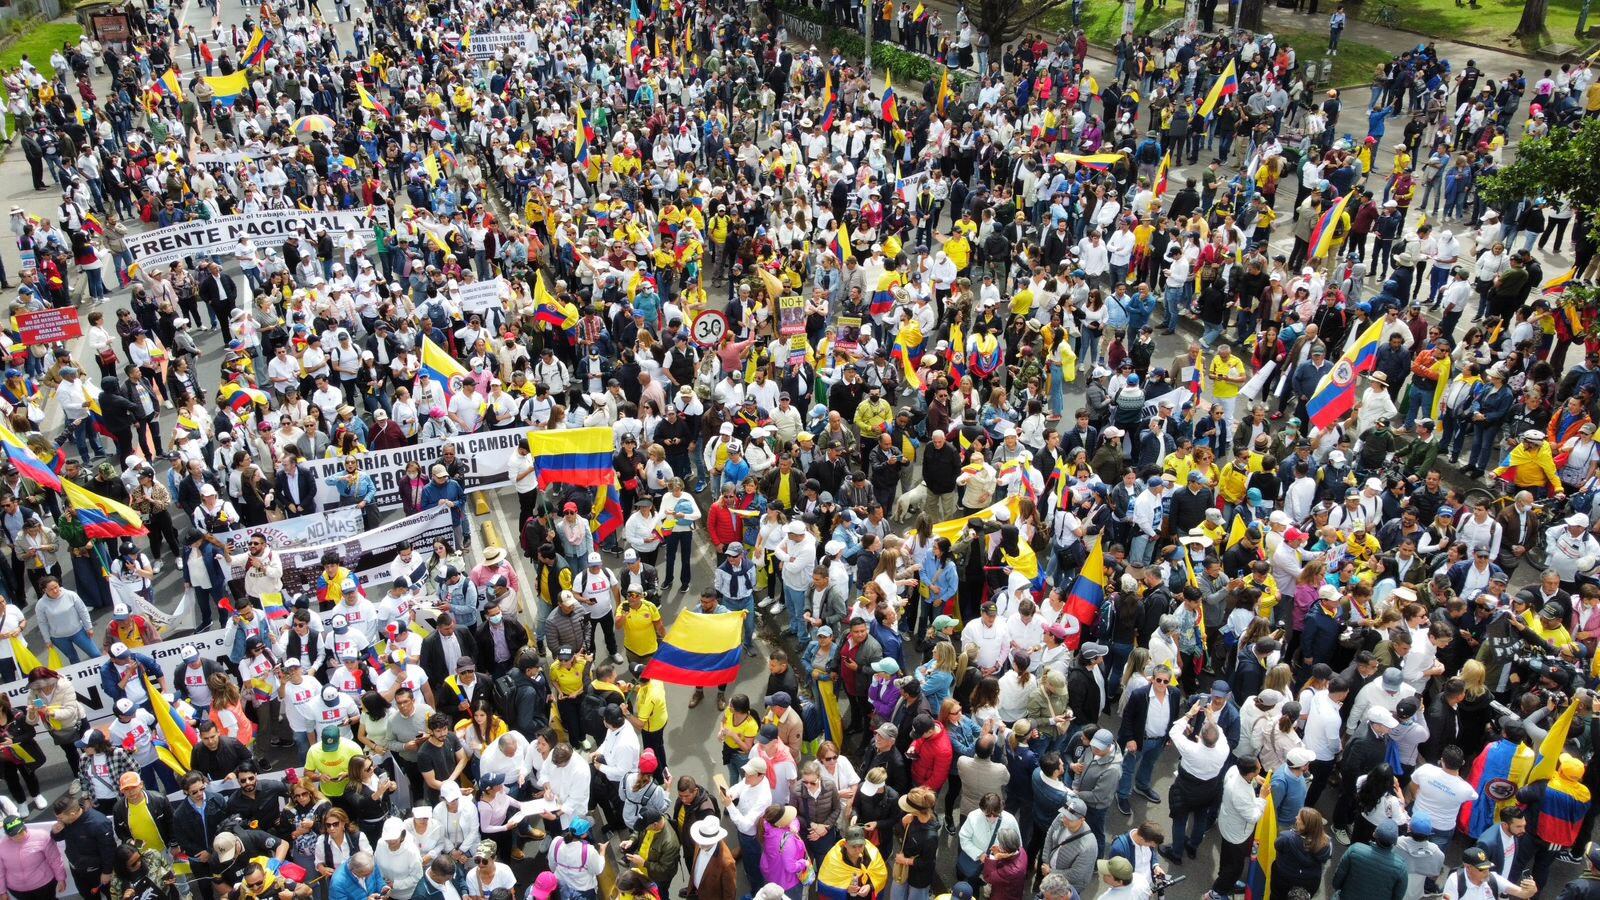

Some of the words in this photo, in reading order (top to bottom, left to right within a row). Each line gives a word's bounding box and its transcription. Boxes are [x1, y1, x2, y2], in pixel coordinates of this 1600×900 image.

[130, 227, 222, 260] FRENTE
[228, 216, 345, 240] NACIONAL
[782, 299, 794, 308] NO
[698, 318, 722, 338] 30
[323, 454, 392, 477] MAORÍA
[392, 444, 442, 466] QUIERE
[468, 434, 522, 453] CAMBIO
[308, 522, 324, 539] NO
[326, 519, 356, 534] MAS
